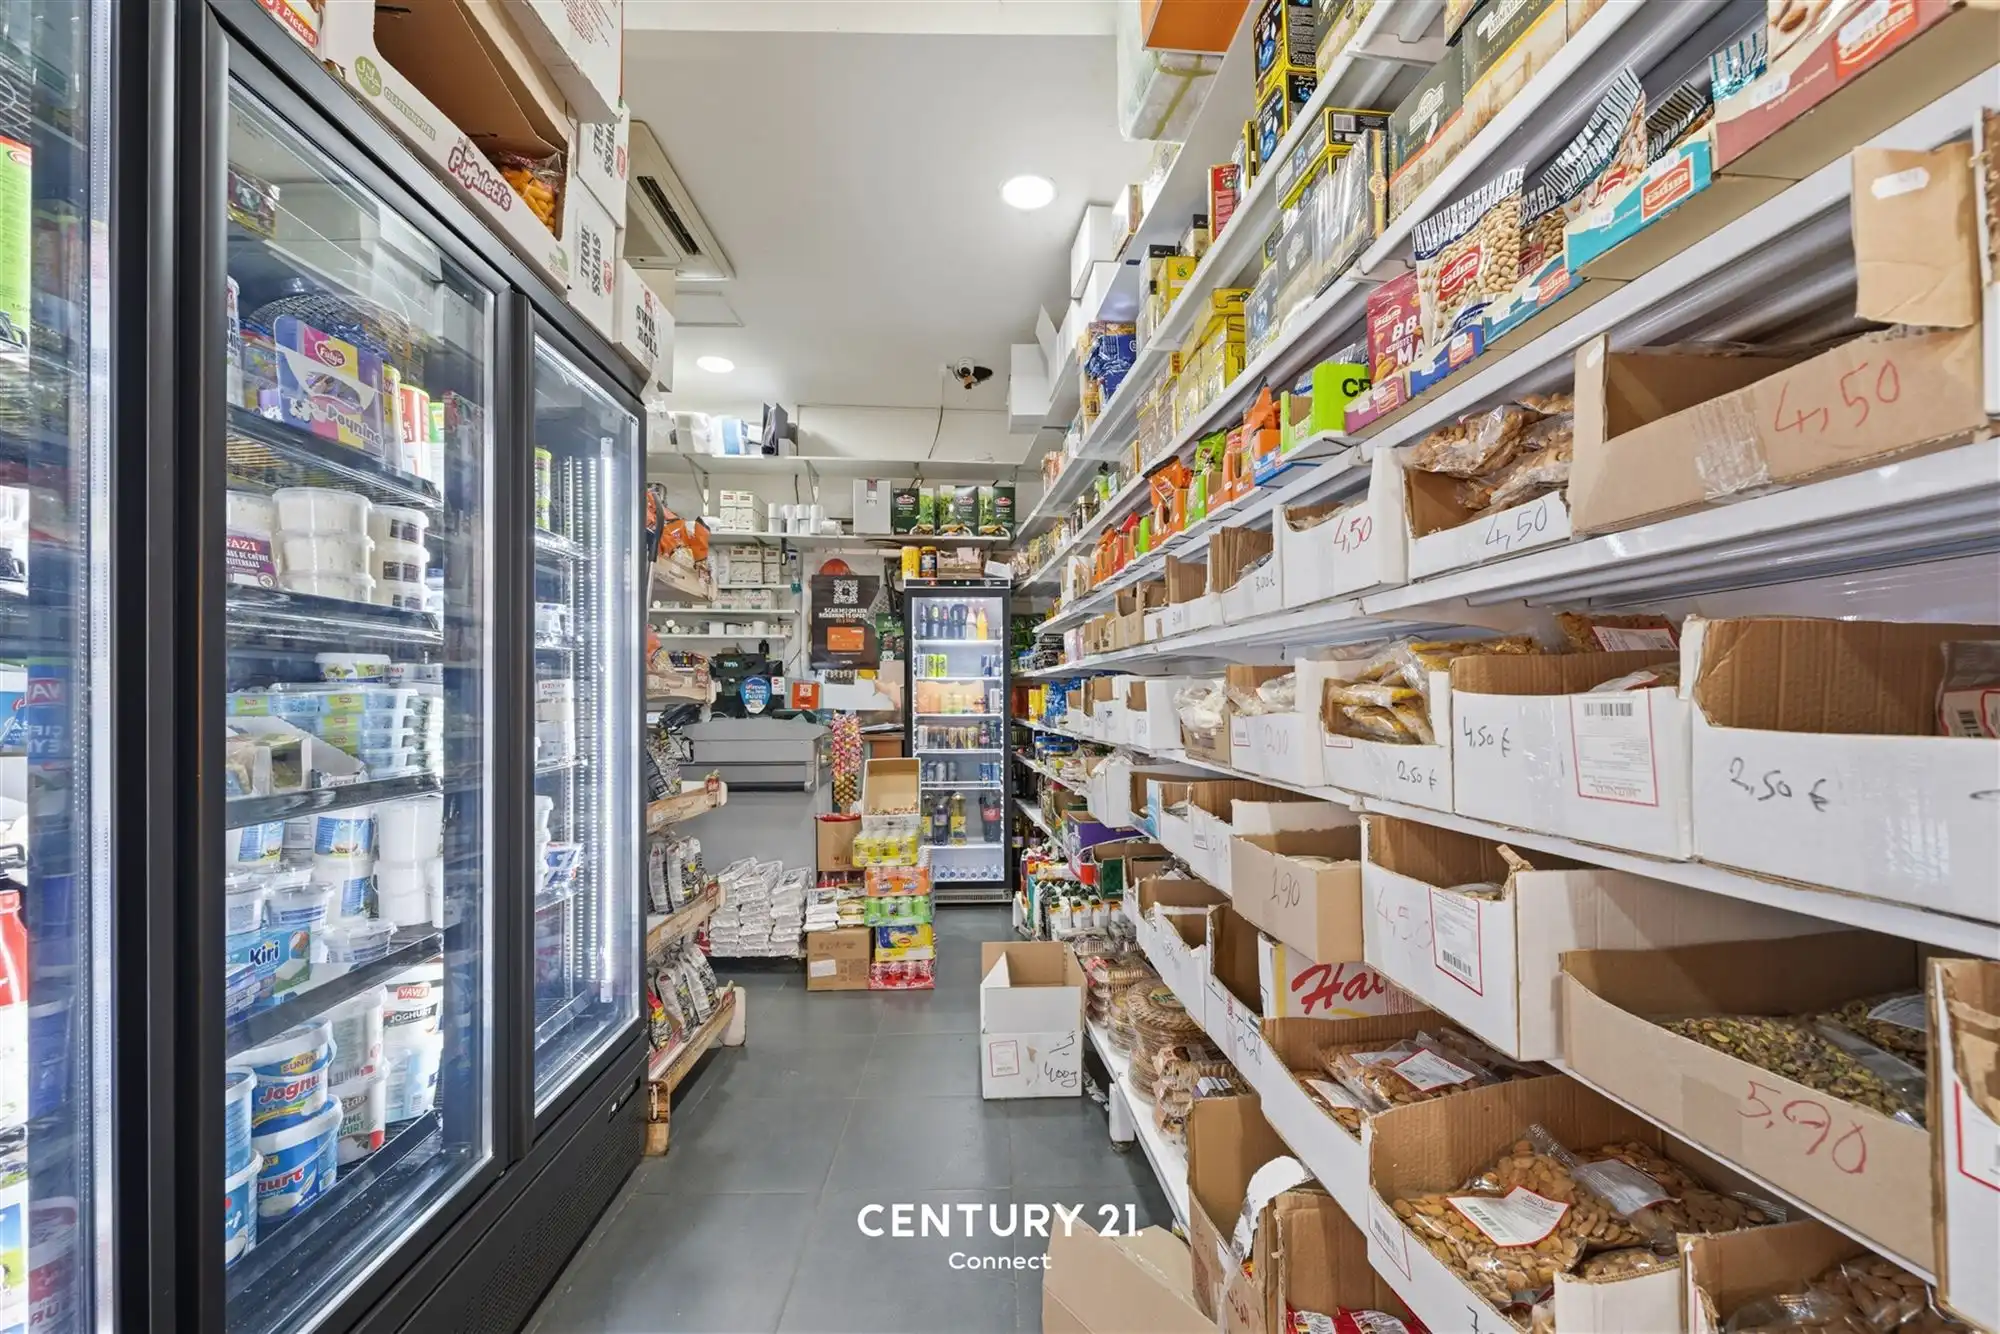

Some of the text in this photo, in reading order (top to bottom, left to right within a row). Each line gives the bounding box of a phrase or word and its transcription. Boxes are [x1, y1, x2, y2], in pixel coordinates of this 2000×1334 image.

[1773, 359, 1901, 434] 4,50
[1333, 514, 1373, 553] 4,50
[1485, 500, 1548, 550] 4,50
[1728, 756, 1829, 812] 2,50 €
[250, 940, 280, 966] Kiri
[388, 1007, 432, 1024] JOGHURT
